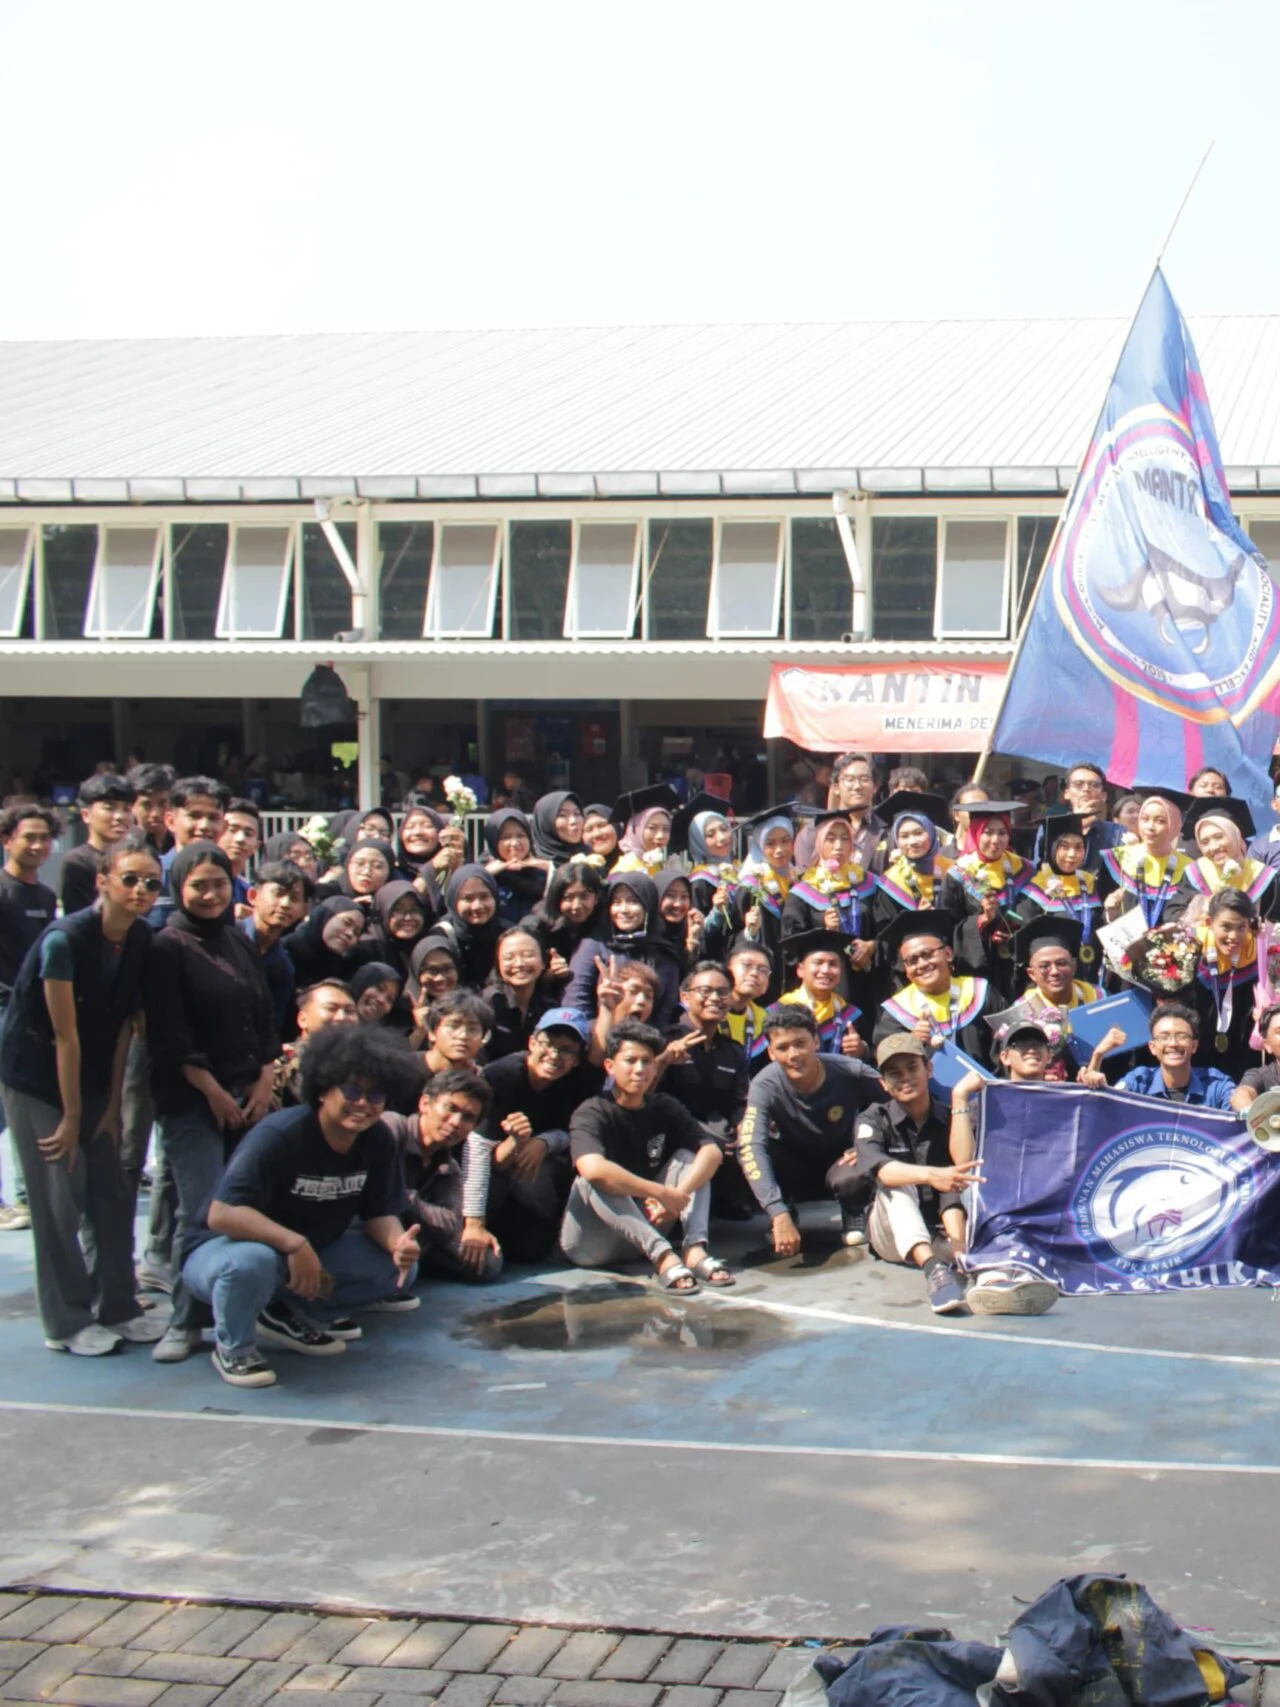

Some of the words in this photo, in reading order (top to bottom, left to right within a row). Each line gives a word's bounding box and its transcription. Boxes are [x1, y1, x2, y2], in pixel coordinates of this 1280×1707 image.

[1132, 466, 1202, 519] MANTR
[1213, 663, 1252, 697] EXCELL
[884, 716, 963, 731] MENERIMA
[970, 716, 994, 731] DE
[1092, 1132, 1154, 1178] MAHASISWA
